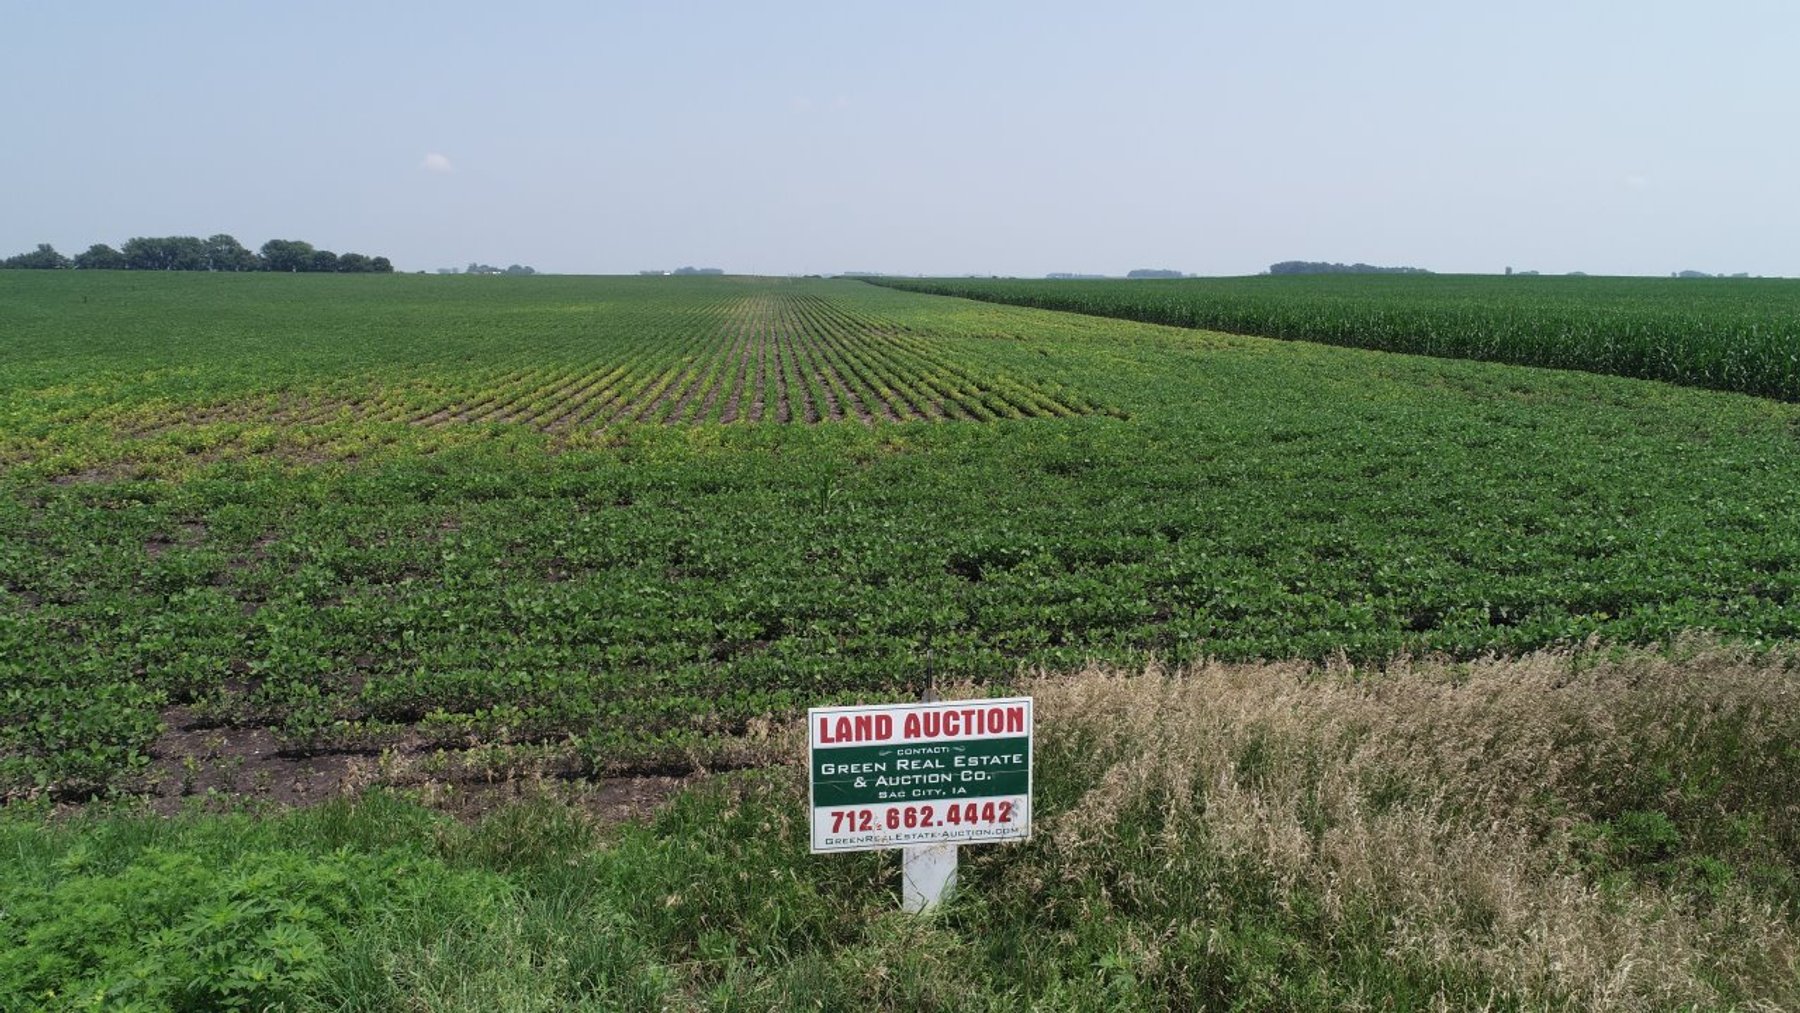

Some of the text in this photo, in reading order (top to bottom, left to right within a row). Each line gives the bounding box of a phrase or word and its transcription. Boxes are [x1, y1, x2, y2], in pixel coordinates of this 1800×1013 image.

[820, 707, 1024, 744] LAND AUCTION
[821, 754, 1023, 775] GREEN REAL ESTATE
[854, 771, 991, 788] & AUCTION CO.
[831, 801, 1012, 834] 712.662.4442
